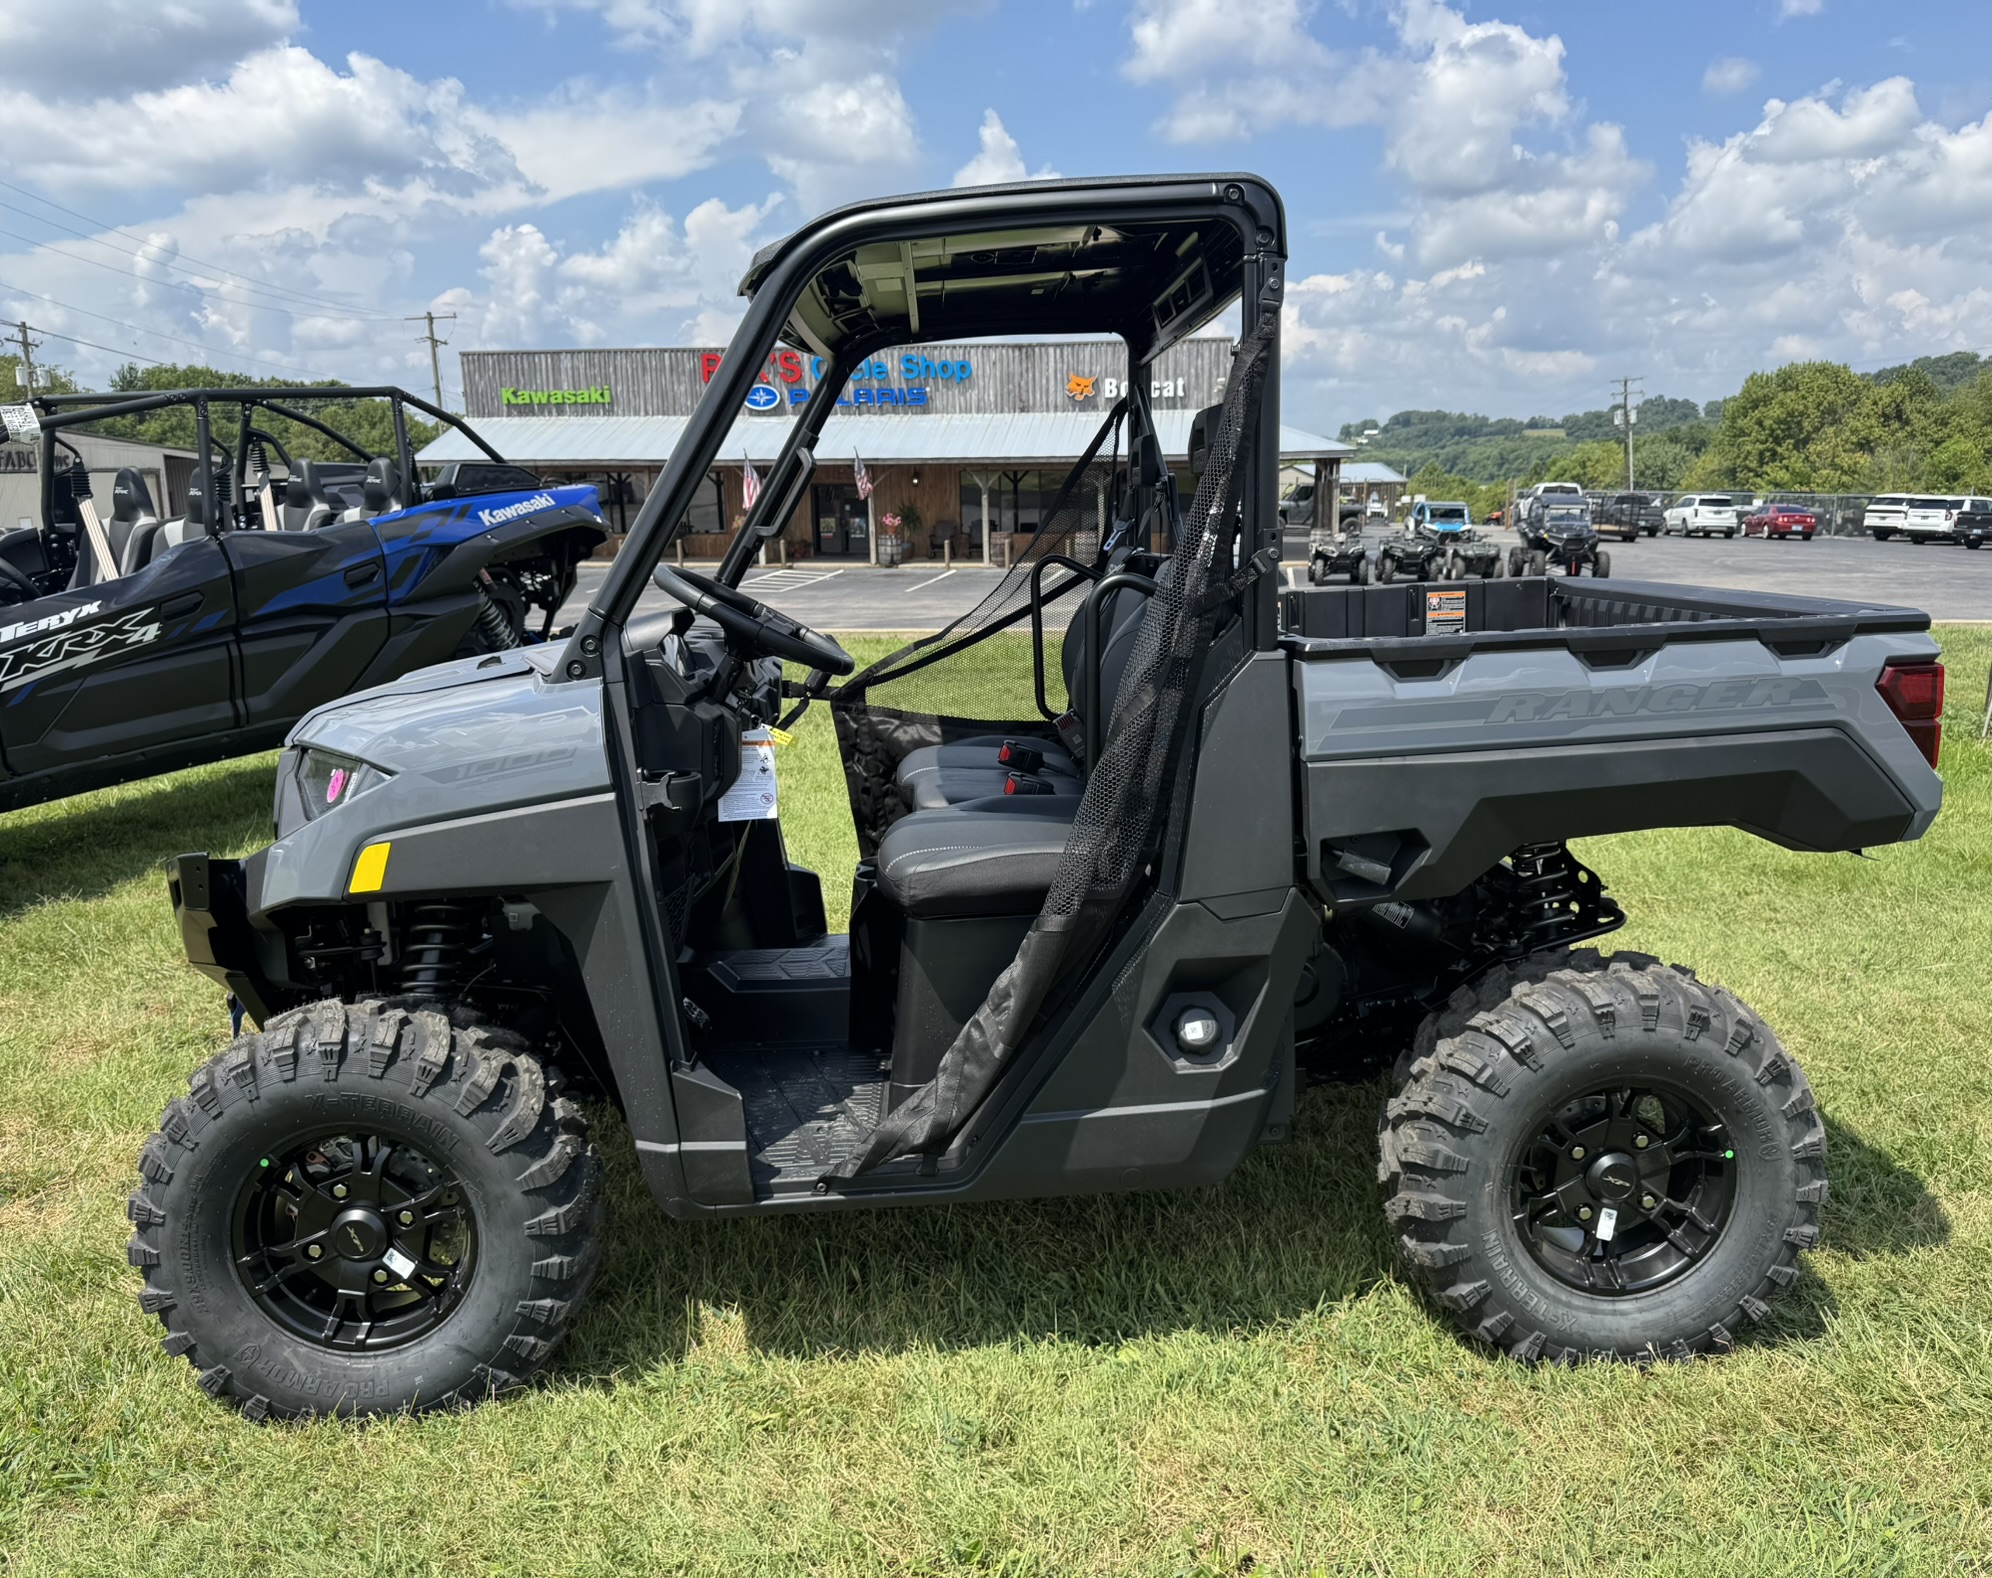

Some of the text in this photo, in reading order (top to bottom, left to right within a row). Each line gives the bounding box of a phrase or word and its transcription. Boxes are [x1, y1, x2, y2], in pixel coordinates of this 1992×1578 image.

[901, 354, 972, 384] Shop
[501, 385, 611, 405] Kawasaki
[478, 493, 556, 526] Kawasaki
[1484, 677, 1801, 724] RANGER
